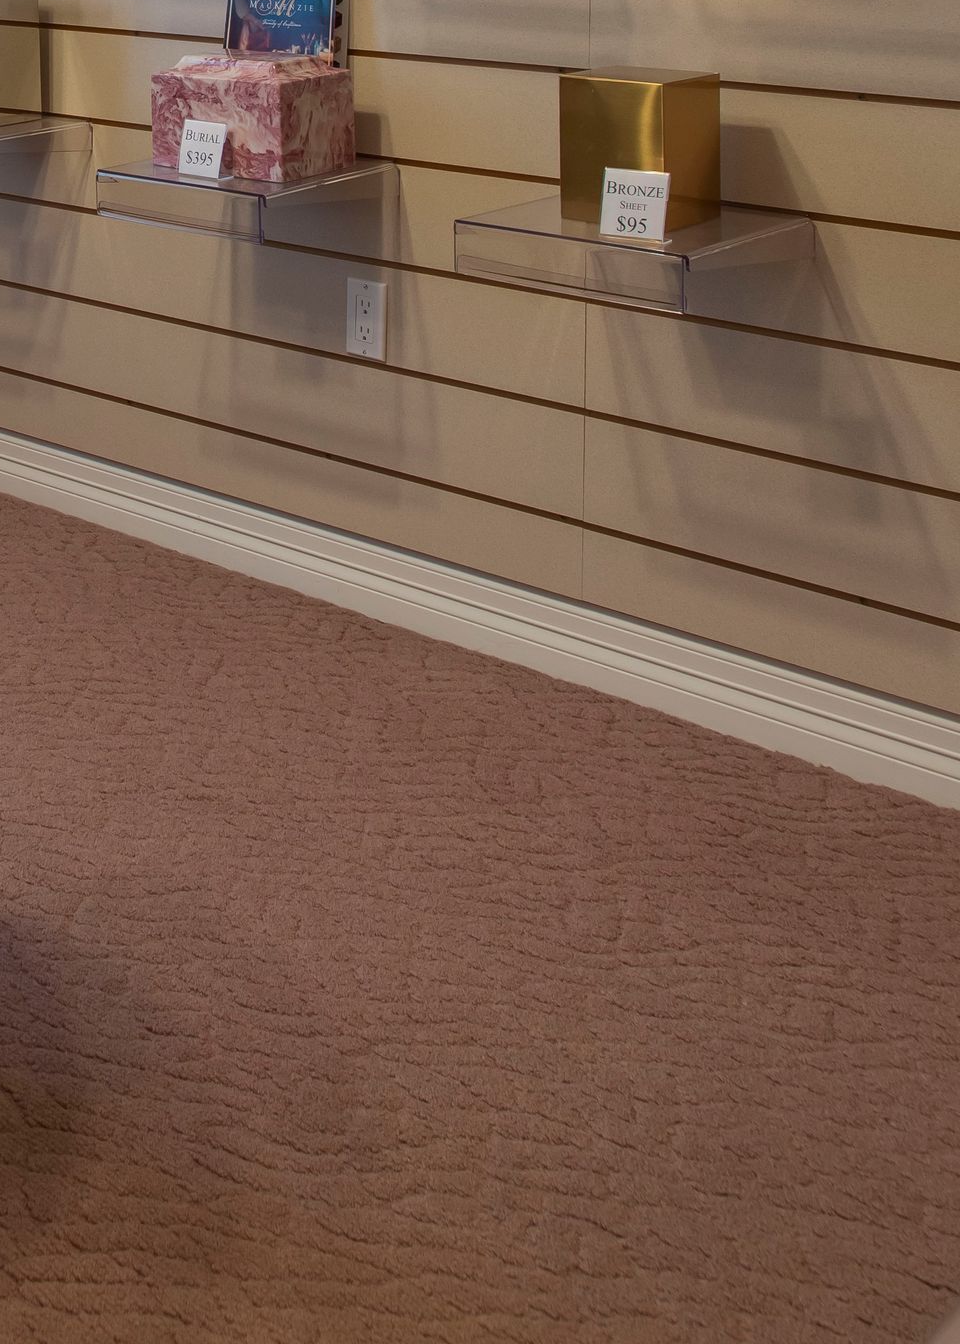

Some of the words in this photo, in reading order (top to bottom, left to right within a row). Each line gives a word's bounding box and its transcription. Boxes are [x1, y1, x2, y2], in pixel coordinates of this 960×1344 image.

[185, 129, 221, 144] BURIAL
[185, 150, 214, 167] $395
[606, 180, 665, 199] BRONZE
[619, 200, 648, 211] SHEET
[616, 215, 648, 234] $95
